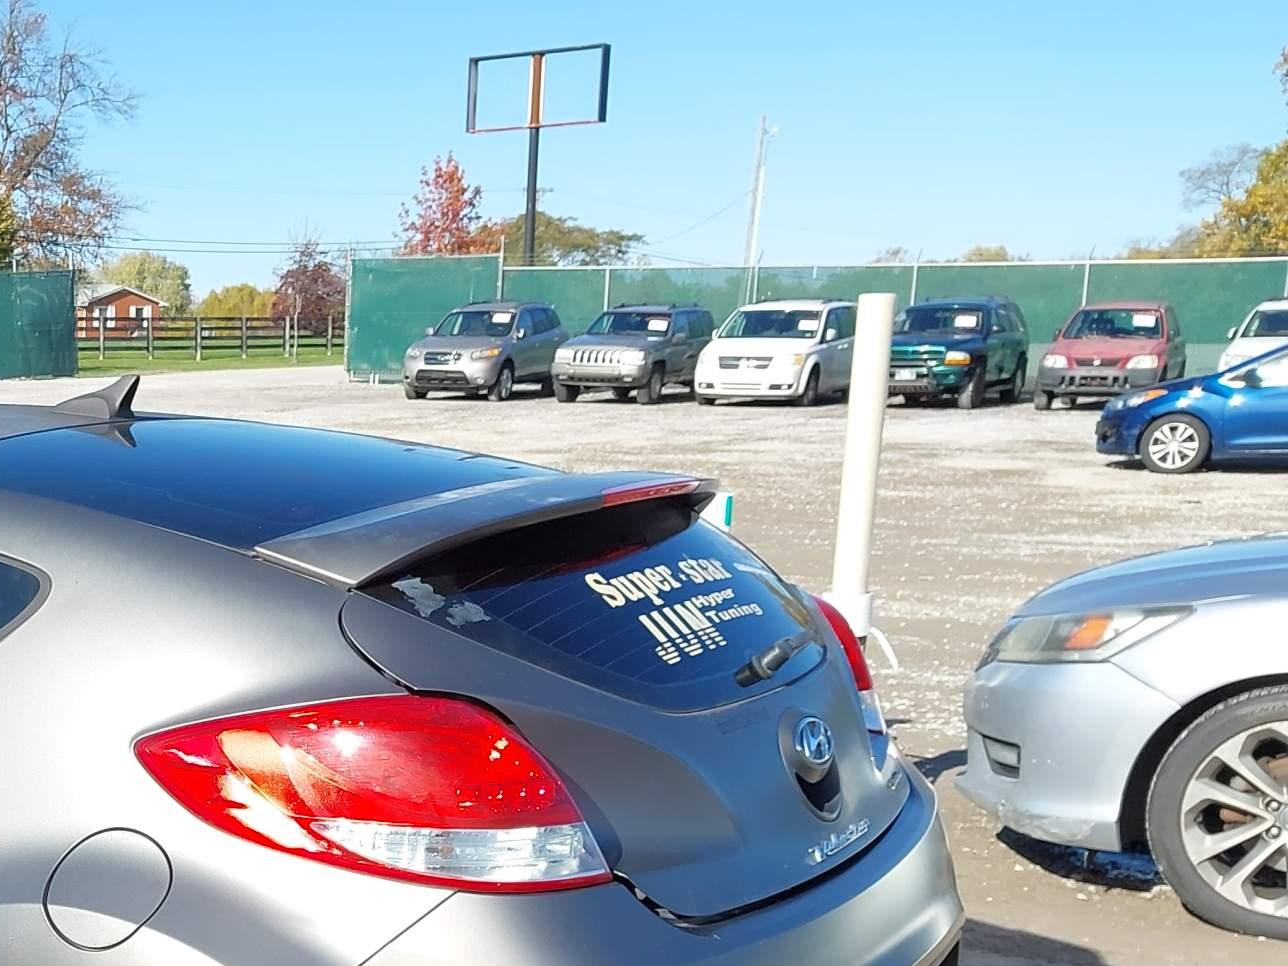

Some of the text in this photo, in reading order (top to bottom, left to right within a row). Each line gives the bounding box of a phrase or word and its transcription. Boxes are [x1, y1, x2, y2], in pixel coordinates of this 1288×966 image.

[585, 558, 733, 608] Super star
[691, 588, 736, 609] Hyper
[705, 603, 763, 624] Tuning
